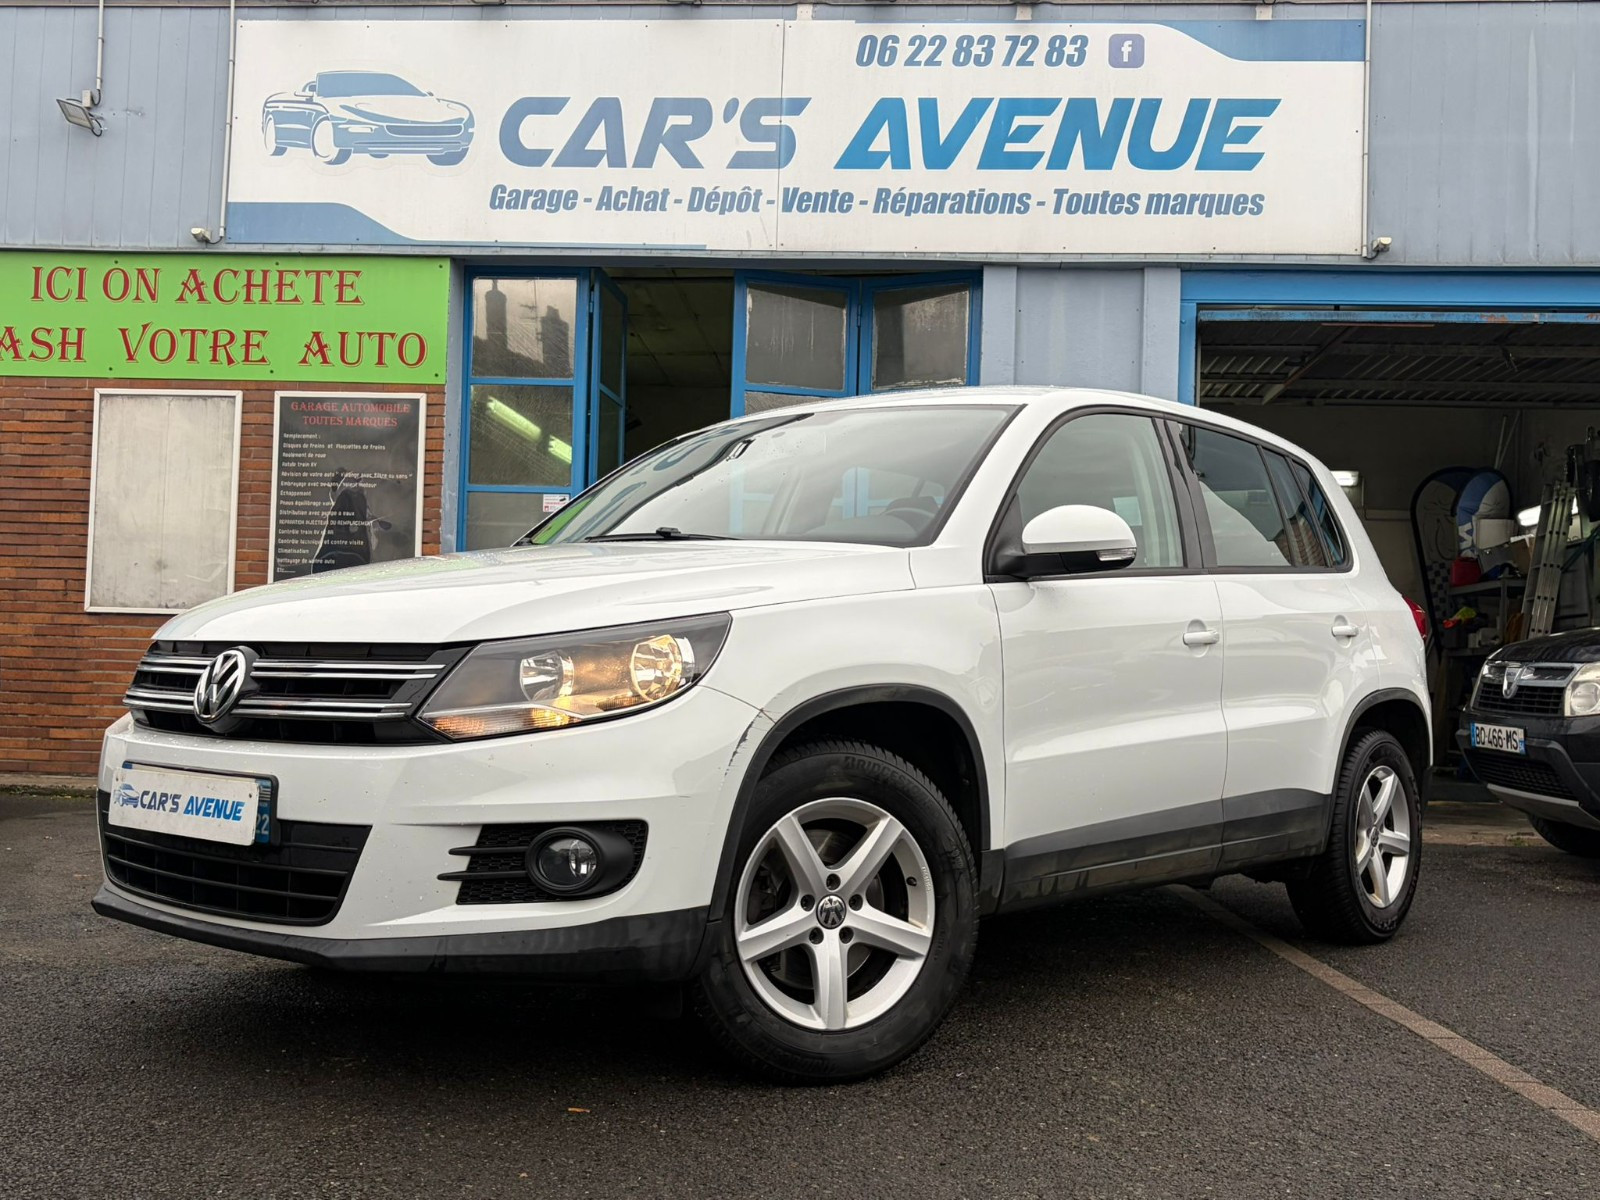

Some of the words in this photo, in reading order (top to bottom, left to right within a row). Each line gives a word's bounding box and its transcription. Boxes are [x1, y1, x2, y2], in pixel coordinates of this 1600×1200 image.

[855, 34, 899, 68] 06
[904, 34, 949, 68] 22
[952, 34, 997, 68] 83
[1003, 34, 1039, 68] 72
[1044, 34, 1089, 68] 83
[499, 96, 813, 170] CAR'S
[833, 97, 1282, 171] AVENUE
[489, 183, 579, 213] Garage
[595, 186, 671, 213] Achat
[687, 185, 763, 216] Dépôt
[781, 187, 854, 214] Vente
[872, 186, 1031, 217] Réparations
[1052, 188, 1140, 216] Toutes
[1144, 193, 1266, 218] marques
[30, 266, 89, 303] ICI
[102, 267, 162, 303] ON
[175, 268, 366, 306] ACHETE
[117, 322, 272, 368] VOTRE
[299, 330, 430, 369] AUTO
[291, 401, 339, 412] GARAGE
[341, 402, 411, 413] AUTOMOBILE
[303, 415, 344, 426] TOUTES
[345, 416, 398, 427] MARQUES
[139, 790, 181, 813] CAR'S
[183, 796, 245, 822] AVENUE
